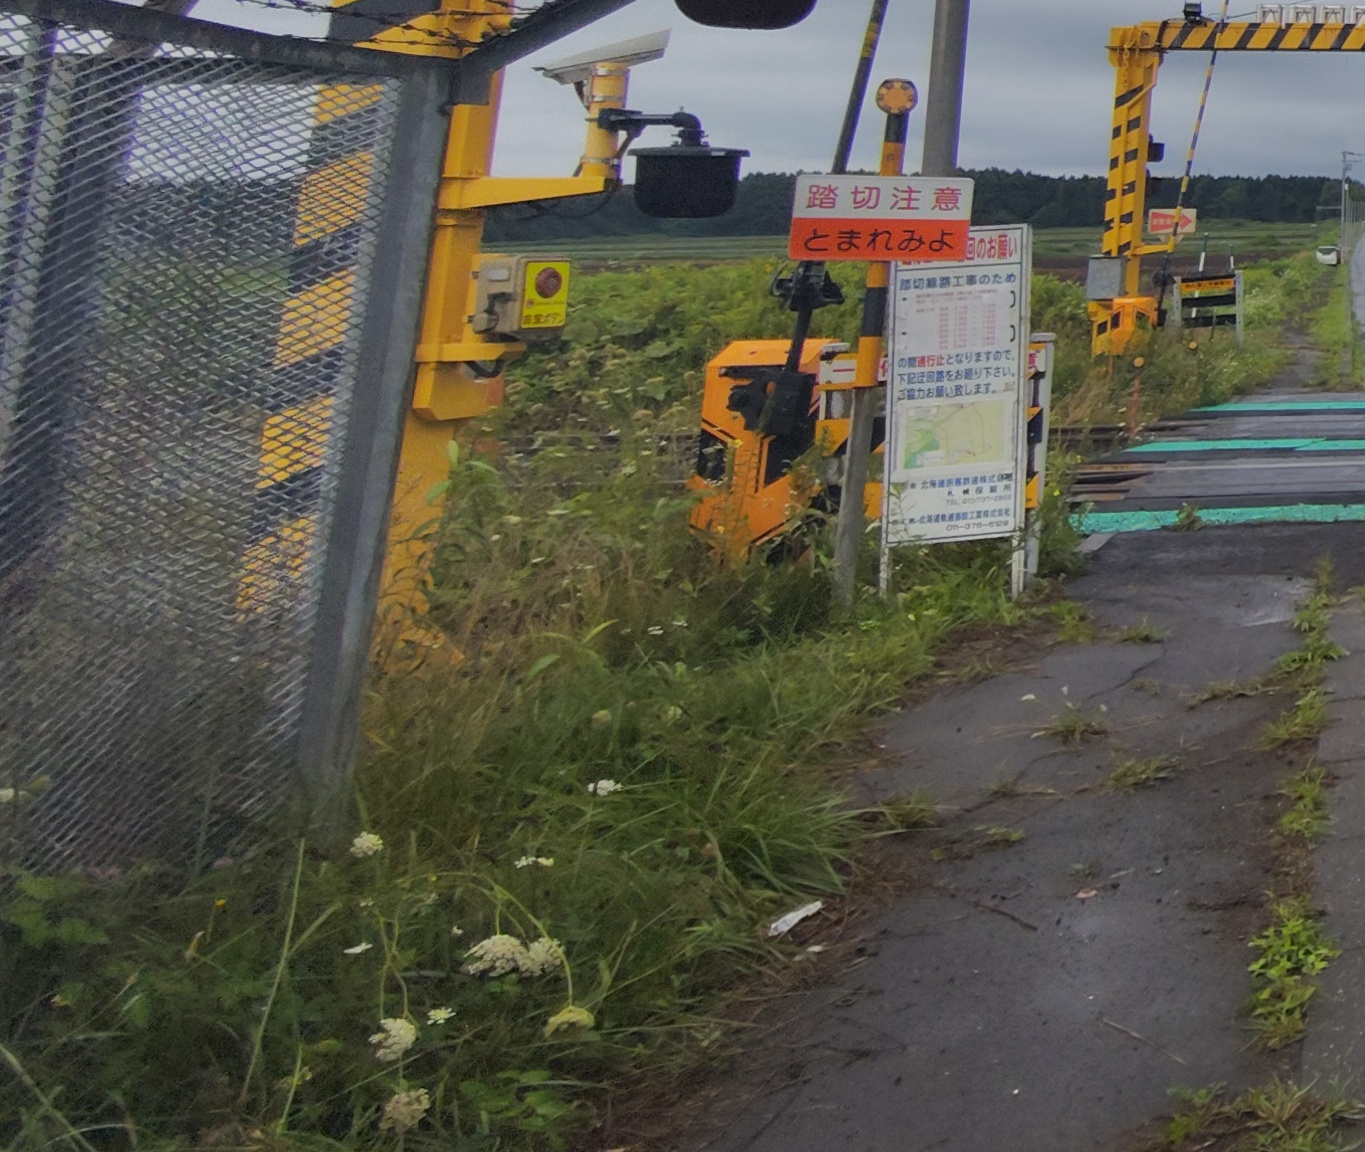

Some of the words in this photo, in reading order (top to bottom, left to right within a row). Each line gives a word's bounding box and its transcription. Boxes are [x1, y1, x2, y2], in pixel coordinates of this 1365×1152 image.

[805, 183, 963, 211] 踏切注意
[803, 227, 955, 253] とまれみよ
